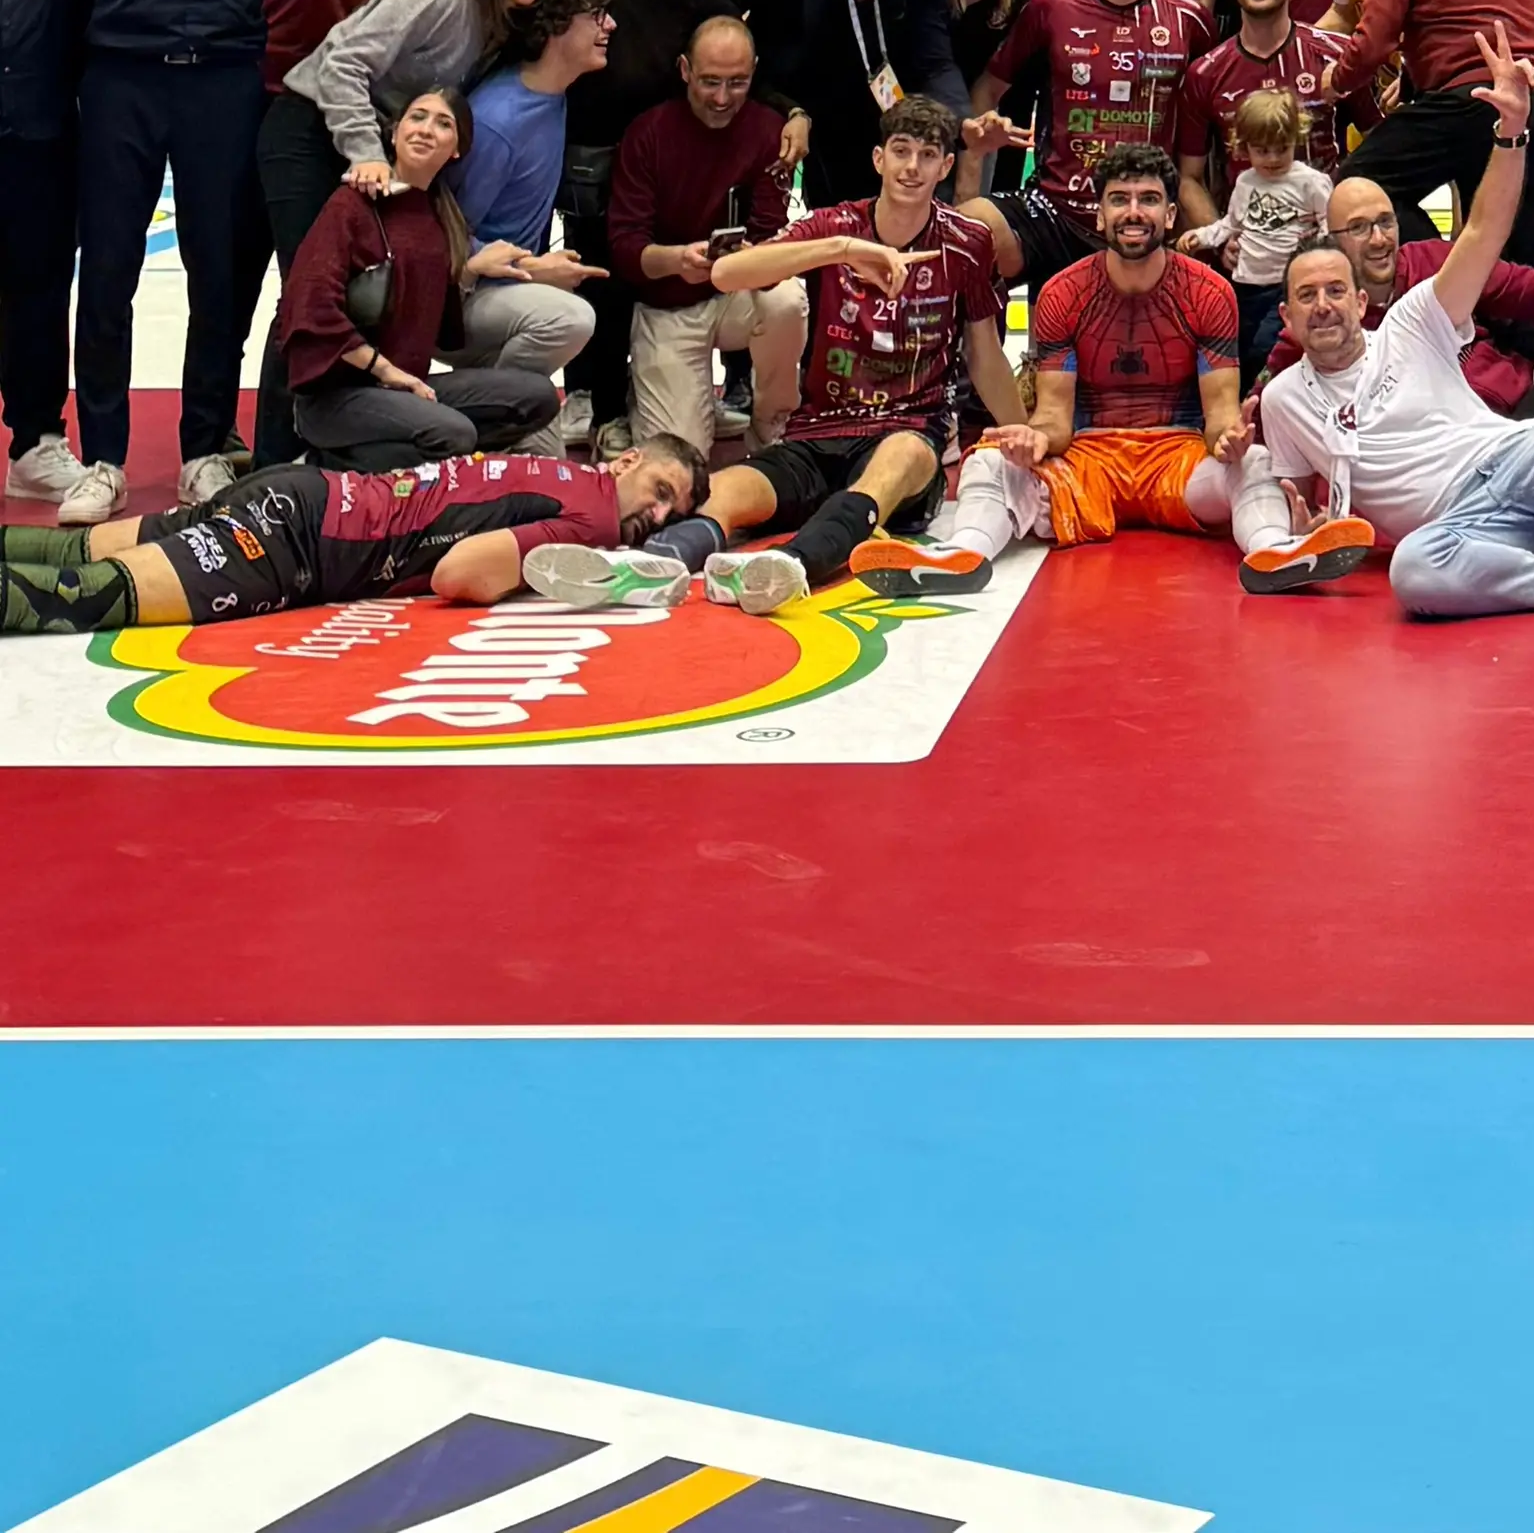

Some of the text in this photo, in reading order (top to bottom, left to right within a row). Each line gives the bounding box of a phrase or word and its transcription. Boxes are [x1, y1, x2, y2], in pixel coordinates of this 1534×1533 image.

[1108, 50, 1136, 72] 35
[872, 299, 898, 321] 29
[211, 591, 239, 613] 8
[254, 597, 416, 659] uality
